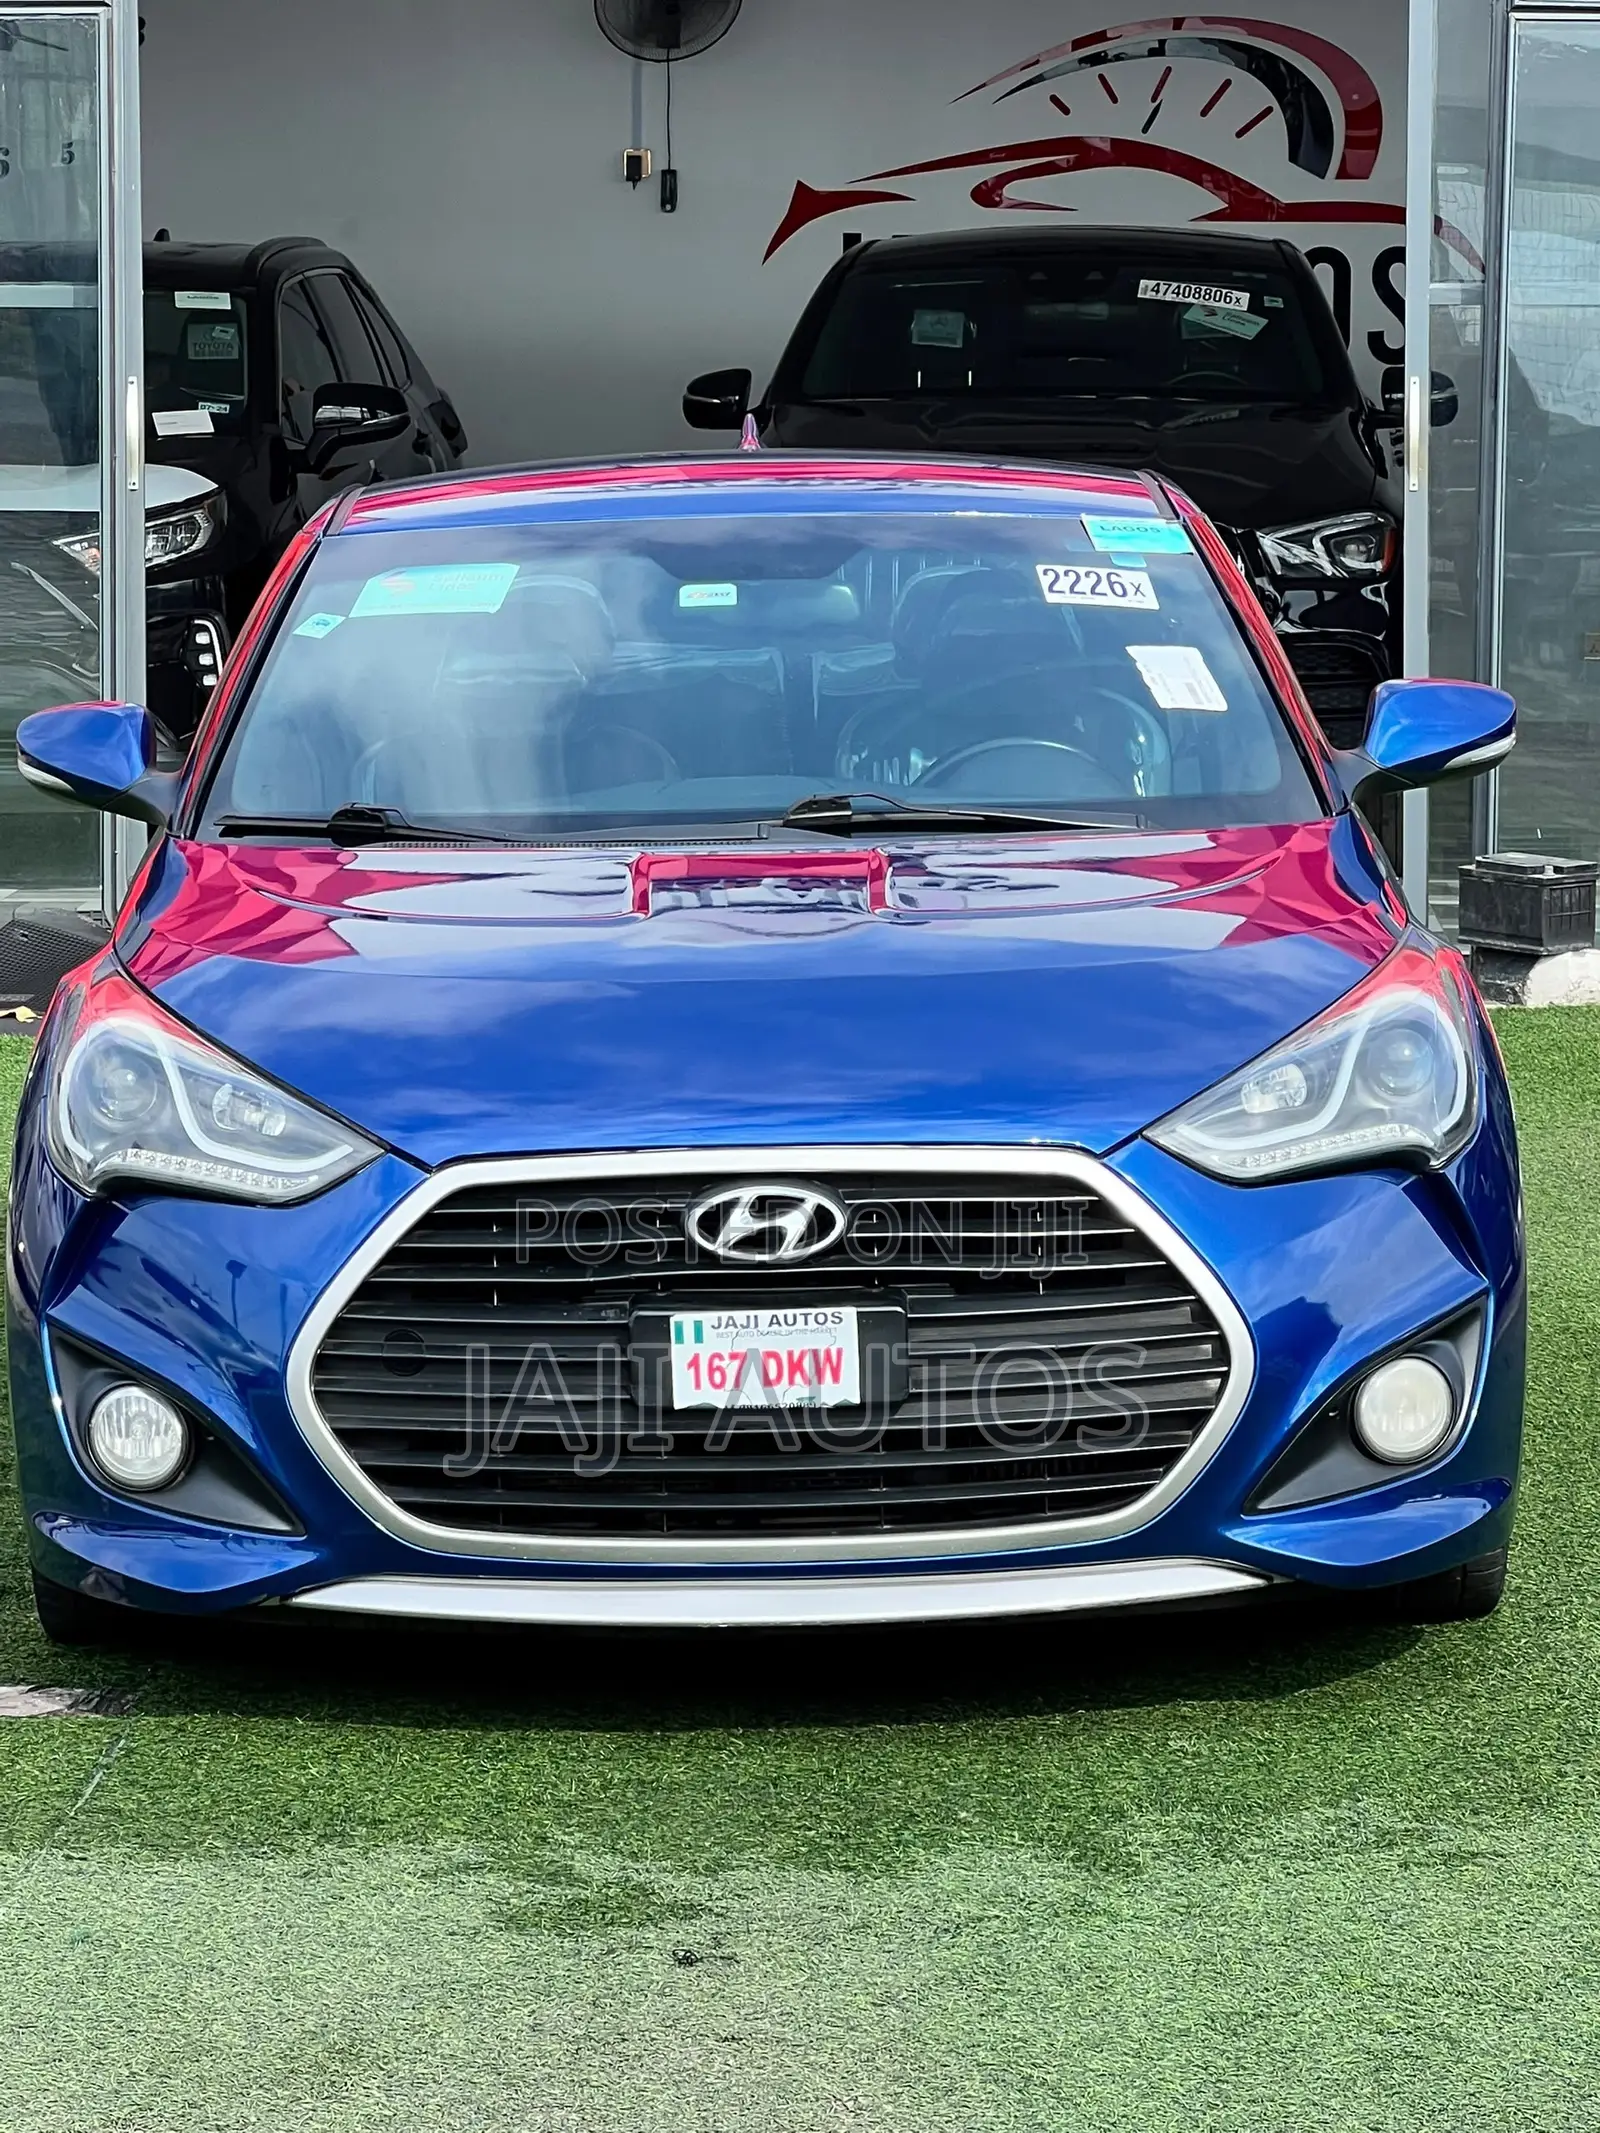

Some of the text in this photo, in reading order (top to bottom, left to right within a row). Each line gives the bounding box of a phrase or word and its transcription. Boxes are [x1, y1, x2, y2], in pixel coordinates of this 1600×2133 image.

[61, 141, 75, 165] 5
[192, 341, 234, 350] TOYOTA
[1099, 525, 1161, 534] LAGOS
[711, 1311, 843, 1330] JAJI AUTOS
[686, 1347, 844, 1391] 167 DKW
